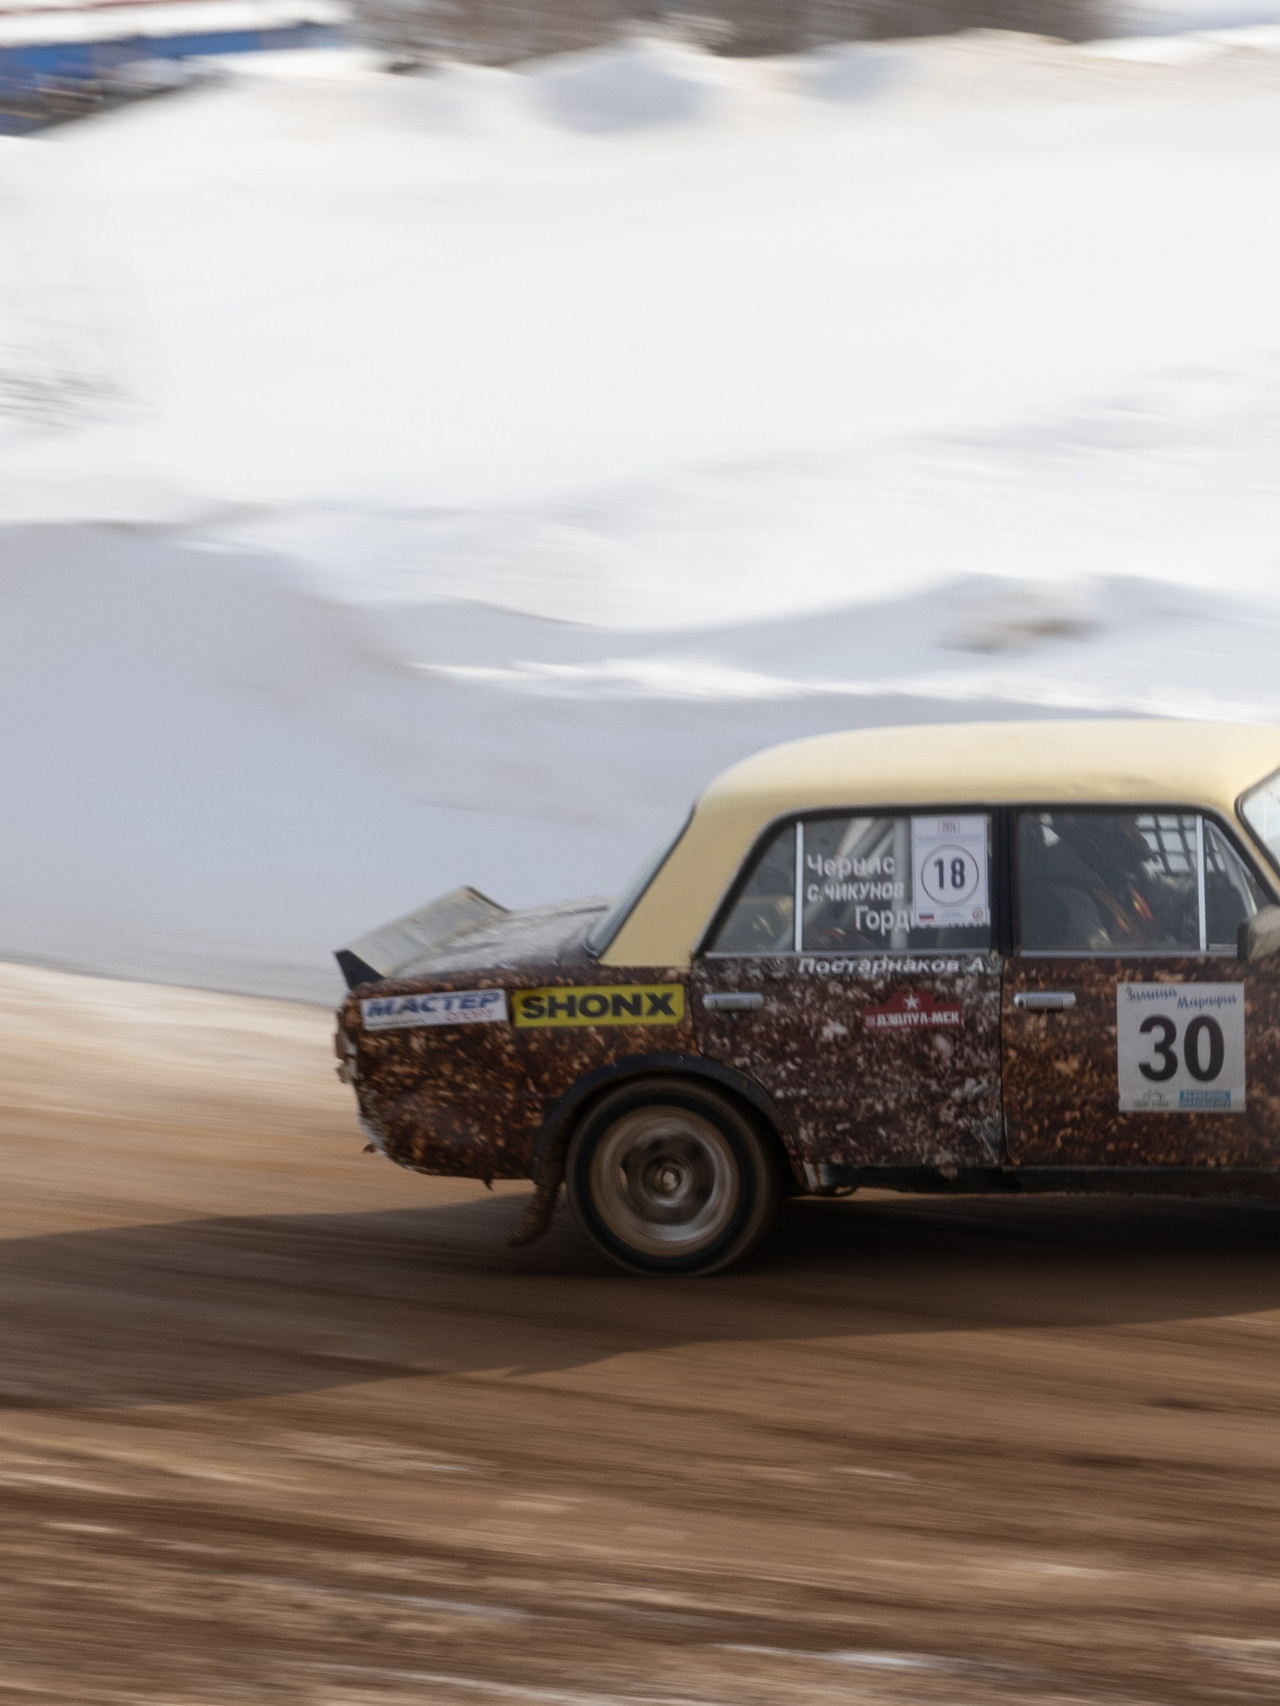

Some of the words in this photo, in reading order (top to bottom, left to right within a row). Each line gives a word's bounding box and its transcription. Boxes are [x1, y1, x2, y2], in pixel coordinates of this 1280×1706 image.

[933, 857, 966, 890] 18
[799, 957, 959, 976] Постарнаков
[366, 992, 502, 1018] МАСТЕР
[520, 992, 678, 1020] SHONX
[1138, 1014, 1225, 1082] 30
